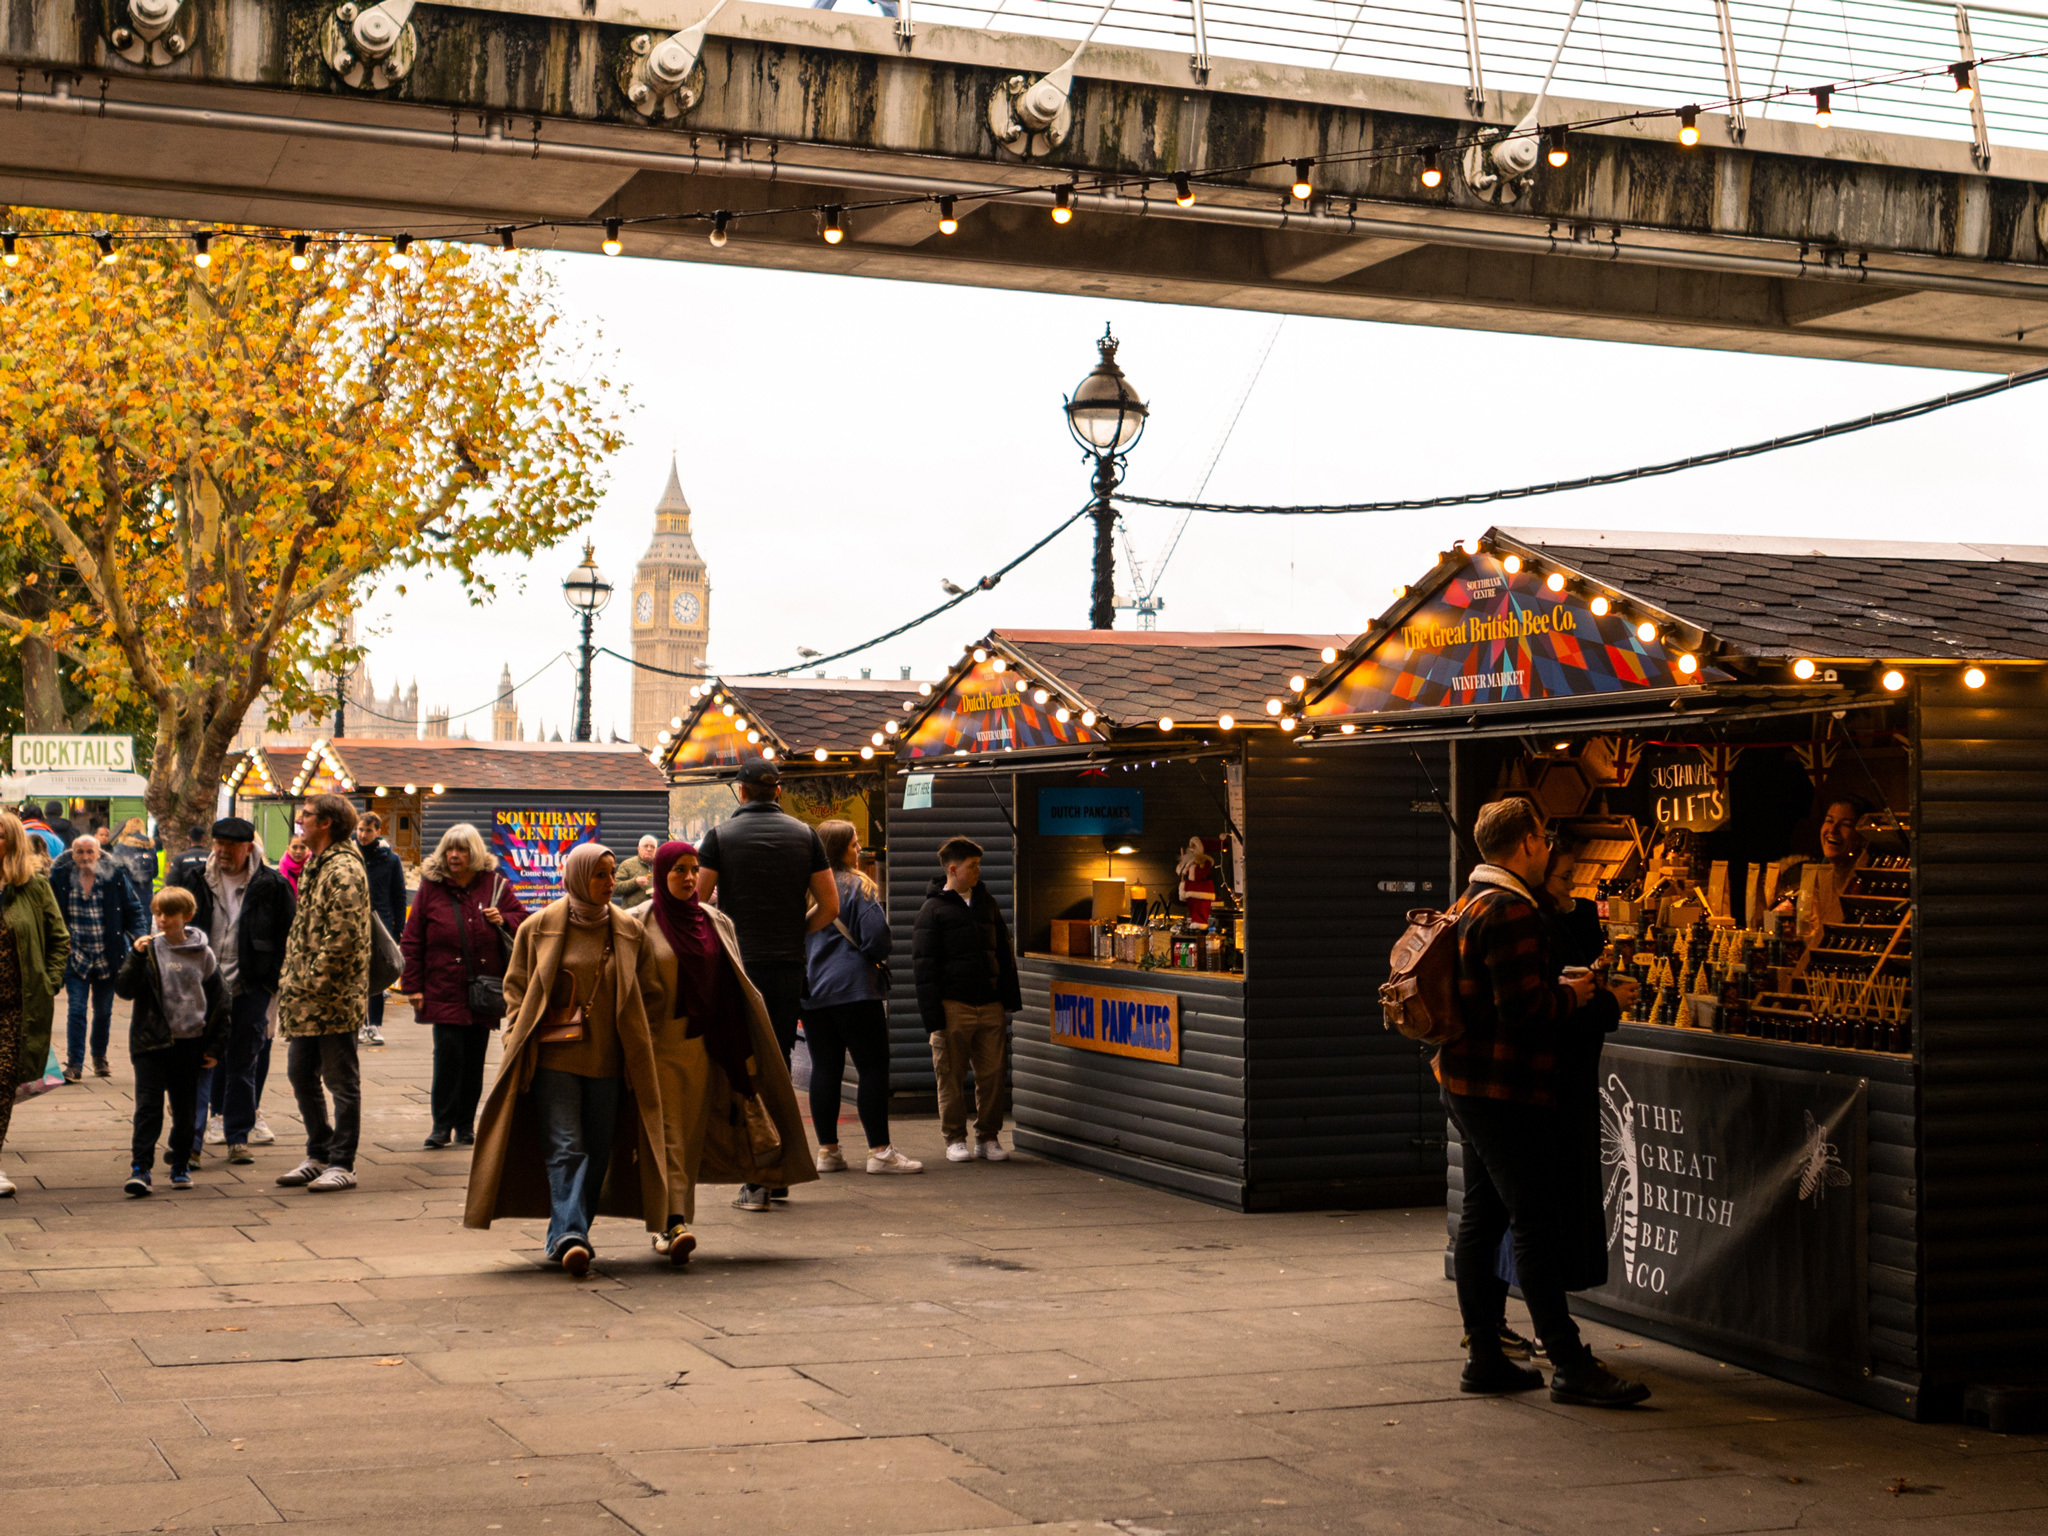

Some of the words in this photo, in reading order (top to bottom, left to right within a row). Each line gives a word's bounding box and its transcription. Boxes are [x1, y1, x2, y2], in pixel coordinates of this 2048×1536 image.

[1466, 576, 1502, 591] SOUTHBANK
[1473, 588, 1496, 600] CENTRE
[1401, 625, 1427, 650] The
[1430, 621, 1467, 648] Great
[1469, 611, 1519, 643] British
[1521, 609, 1550, 636] Bee
[1552, 604, 1577, 632] Co.
[1451, 674, 1486, 691] WINTER
[1487, 670, 1525, 688] MARKET
[962, 692, 985, 713] Dutch
[986, 688, 1021, 711] Pancakes
[976, 730, 995, 742] WINTER
[995, 728, 1013, 741] MARKET
[20, 740, 125, 766] COCKTAILS
[496, 811, 597, 826] SOUTHBANK
[1051, 805, 1081, 818] DUTCH
[1083, 805, 1130, 819] PANCAKES
[1656, 789, 1724, 823] GIFTS
[515, 827, 579, 841] CENTRE
[511, 849, 569, 867] Winte
[520, 869, 542, 877] Come
[1054, 993, 1095, 1040] DUTCH
[1101, 999, 1171, 1052] PANCAKES
[1637, 1103, 1684, 1135] THE
[1641, 1143, 1717, 1182] GREAT
[1642, 1182, 1735, 1228] BRITISH
[1640, 1222, 1679, 1256] BEE
[1636, 1262, 1669, 1296] CO.
